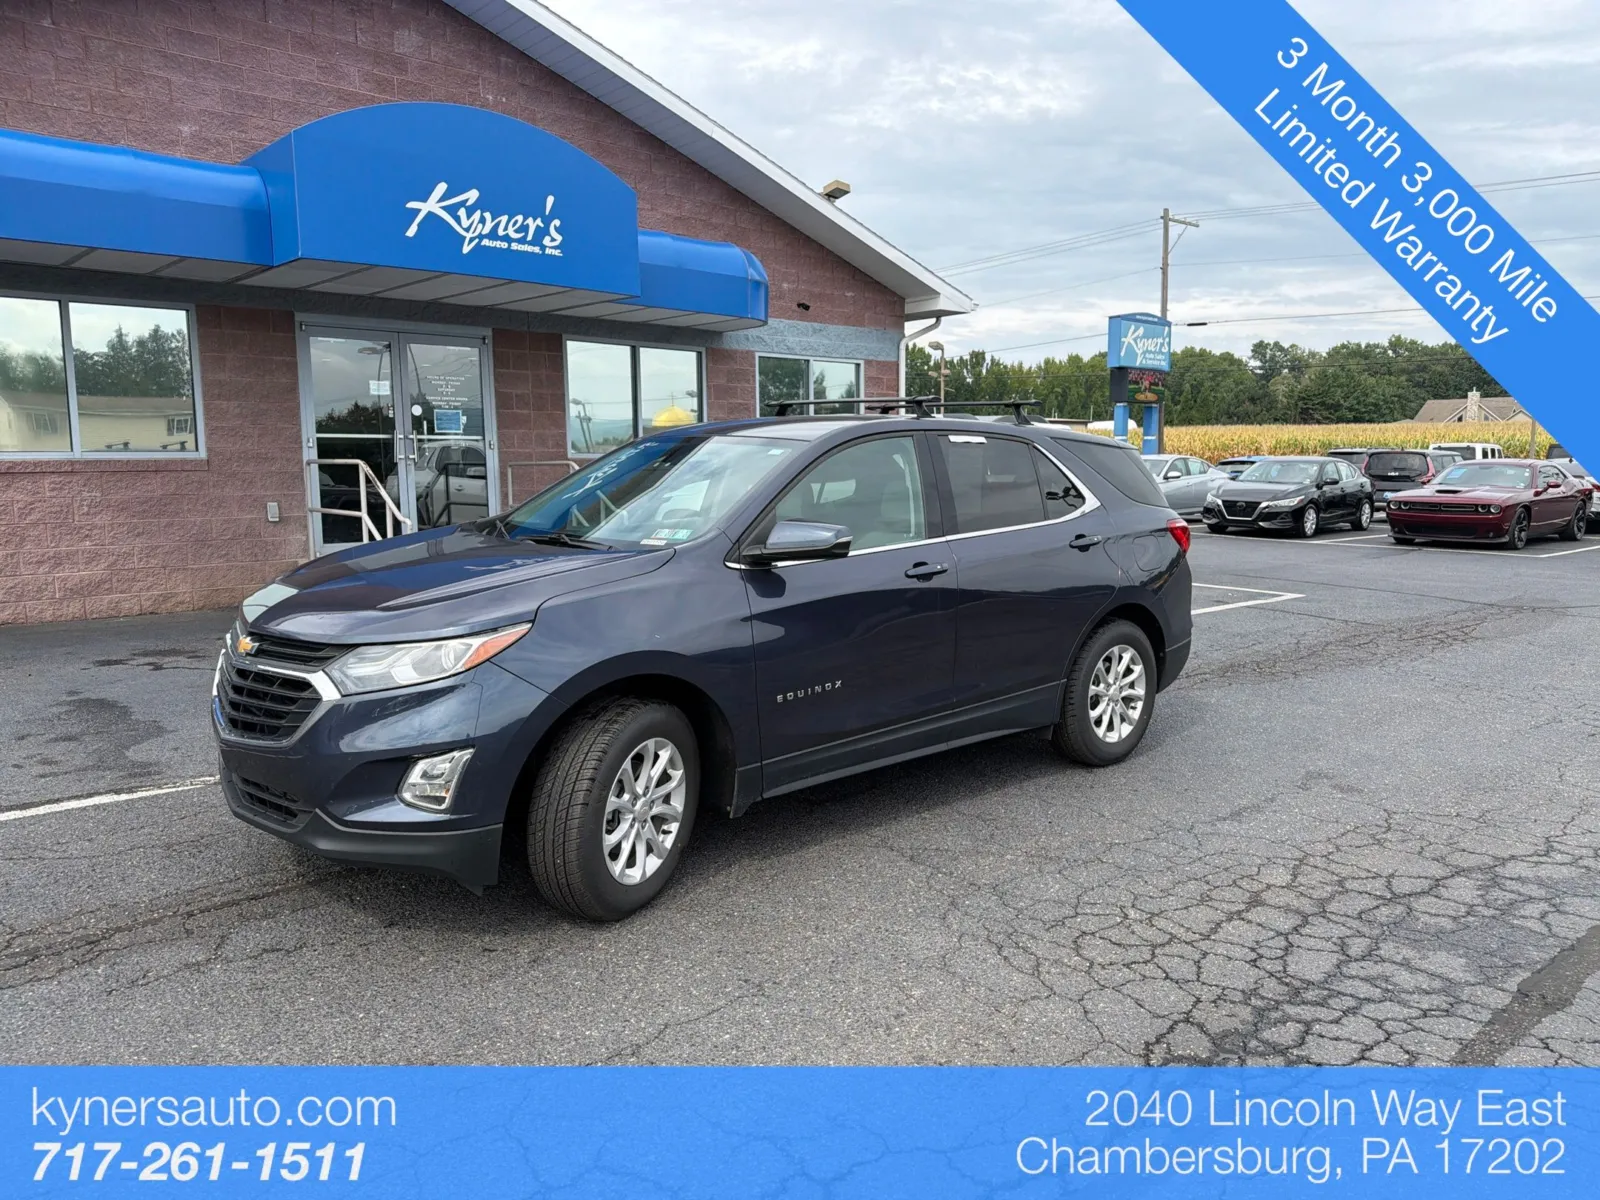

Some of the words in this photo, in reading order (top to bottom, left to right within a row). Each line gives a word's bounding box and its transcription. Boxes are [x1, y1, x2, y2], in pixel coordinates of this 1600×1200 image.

[405, 181, 563, 254] Kyner's
[481, 238, 508, 249] Auto
[510, 242, 543, 254] Sales,
[545, 247, 563, 256] Inc.
[1121, 324, 1169, 366] Kyner's
[776, 680, 842, 703] EQUINOX
